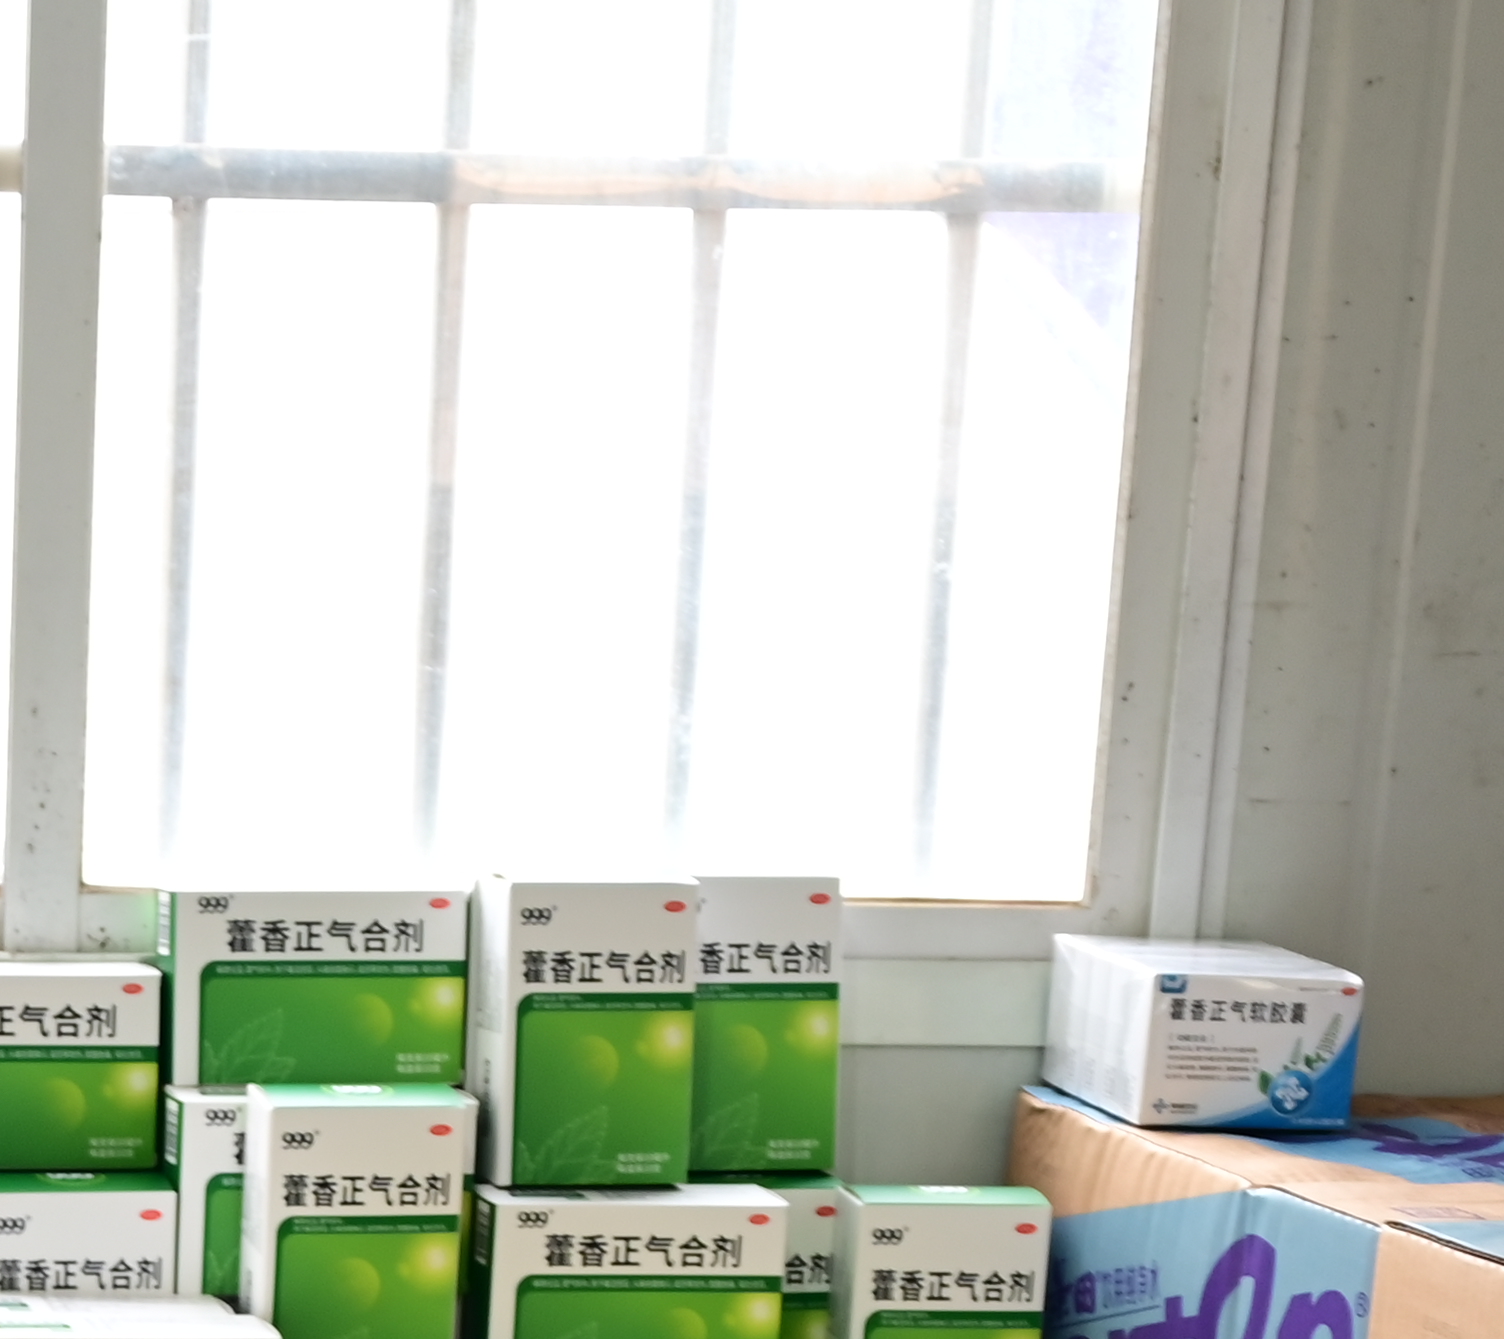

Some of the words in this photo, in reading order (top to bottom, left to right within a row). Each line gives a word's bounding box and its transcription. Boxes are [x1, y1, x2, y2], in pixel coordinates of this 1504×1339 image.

[197, 896, 229, 914] 999
[520, 907, 553, 925] 999
[225, 918, 425, 955] 藿香正气合剂
[522, 951, 686, 985] 藿香正气合剂
[698, 941, 832, 976] 香正气合剂
[204, 1108, 238, 1126] 999
[282, 1131, 316, 1151] 999
[282, 1173, 451, 1208] 藿香正气合剂
[517, 1210, 549, 1228] 999
[872, 1228, 903, 1246] 999
[545, 1234, 742, 1269] 藿香正气合剂
[871, 1270, 1035, 1302] 藿香正气合剂
